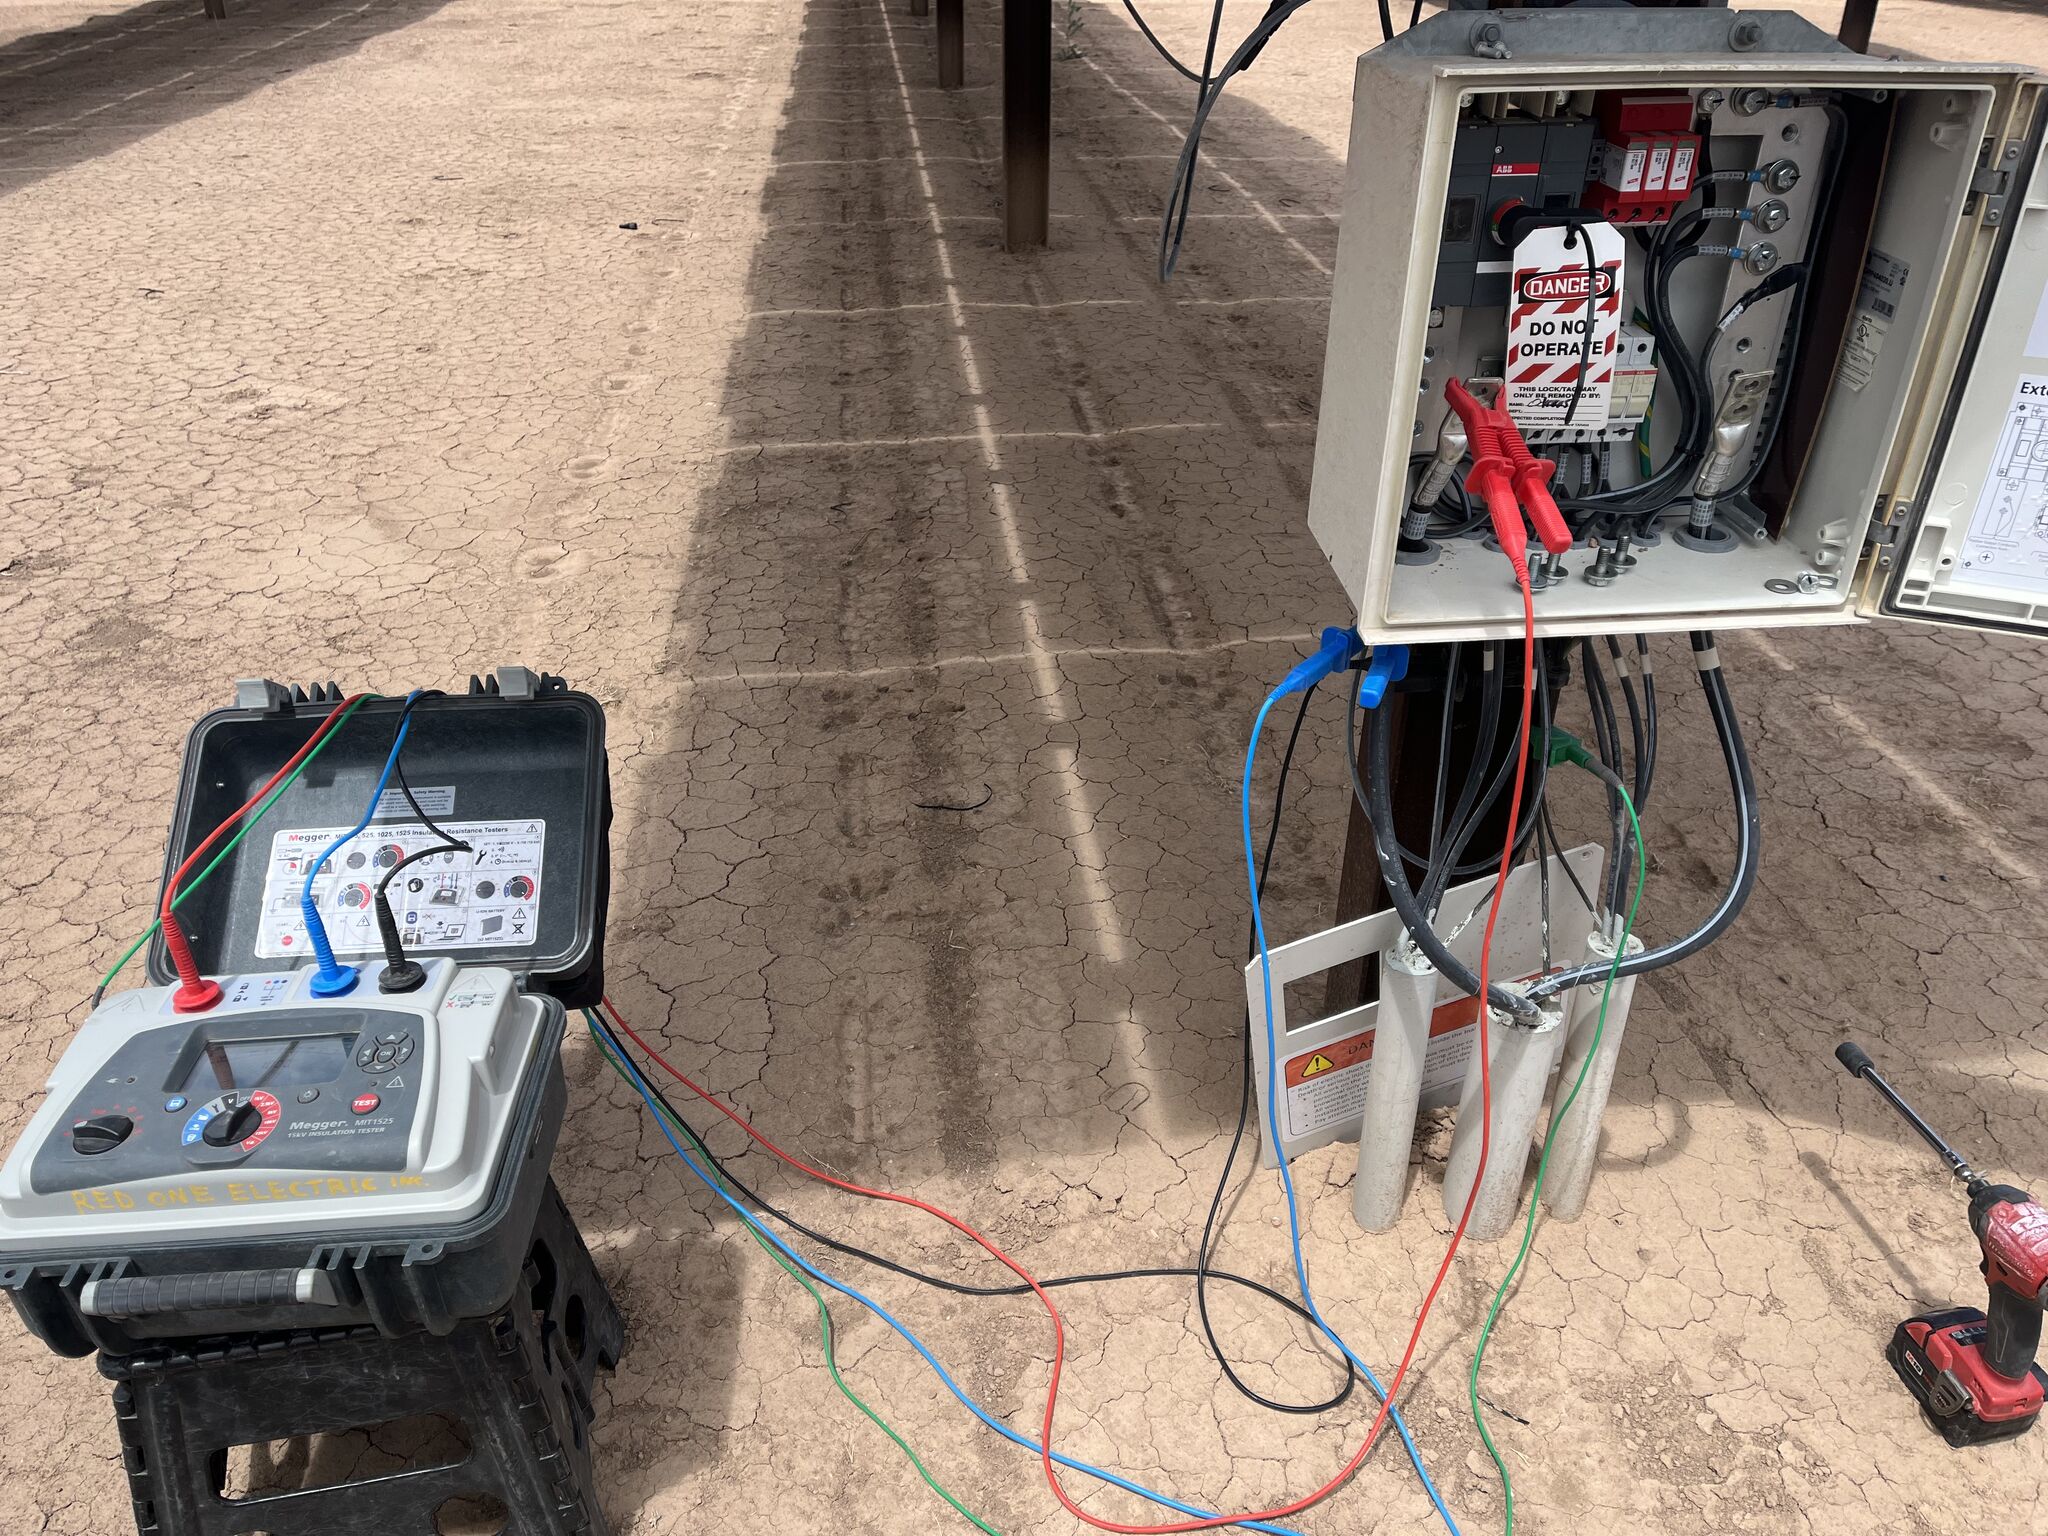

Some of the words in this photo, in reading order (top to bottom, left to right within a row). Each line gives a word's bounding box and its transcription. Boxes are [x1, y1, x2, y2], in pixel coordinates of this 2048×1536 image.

[1496, 165, 1513, 174] ABB
[1530, 275, 1606, 296] DANGER
[1529, 321, 1556, 337] DO
[446, 827, 483, 835] Resistance
[1320, 1073, 1344, 1084] electric
[1345, 1065, 1363, 1076] shock
[1297, 1088, 1318, 1098] Death
[354, 1117, 395, 1126] MIT1525
[308, 1129, 356, 1137] INSULATION
[71, 1189, 135, 1215] RED
[149, 1183, 215, 1207] ONE
[227, 1177, 378, 1202] ELECTRIC
